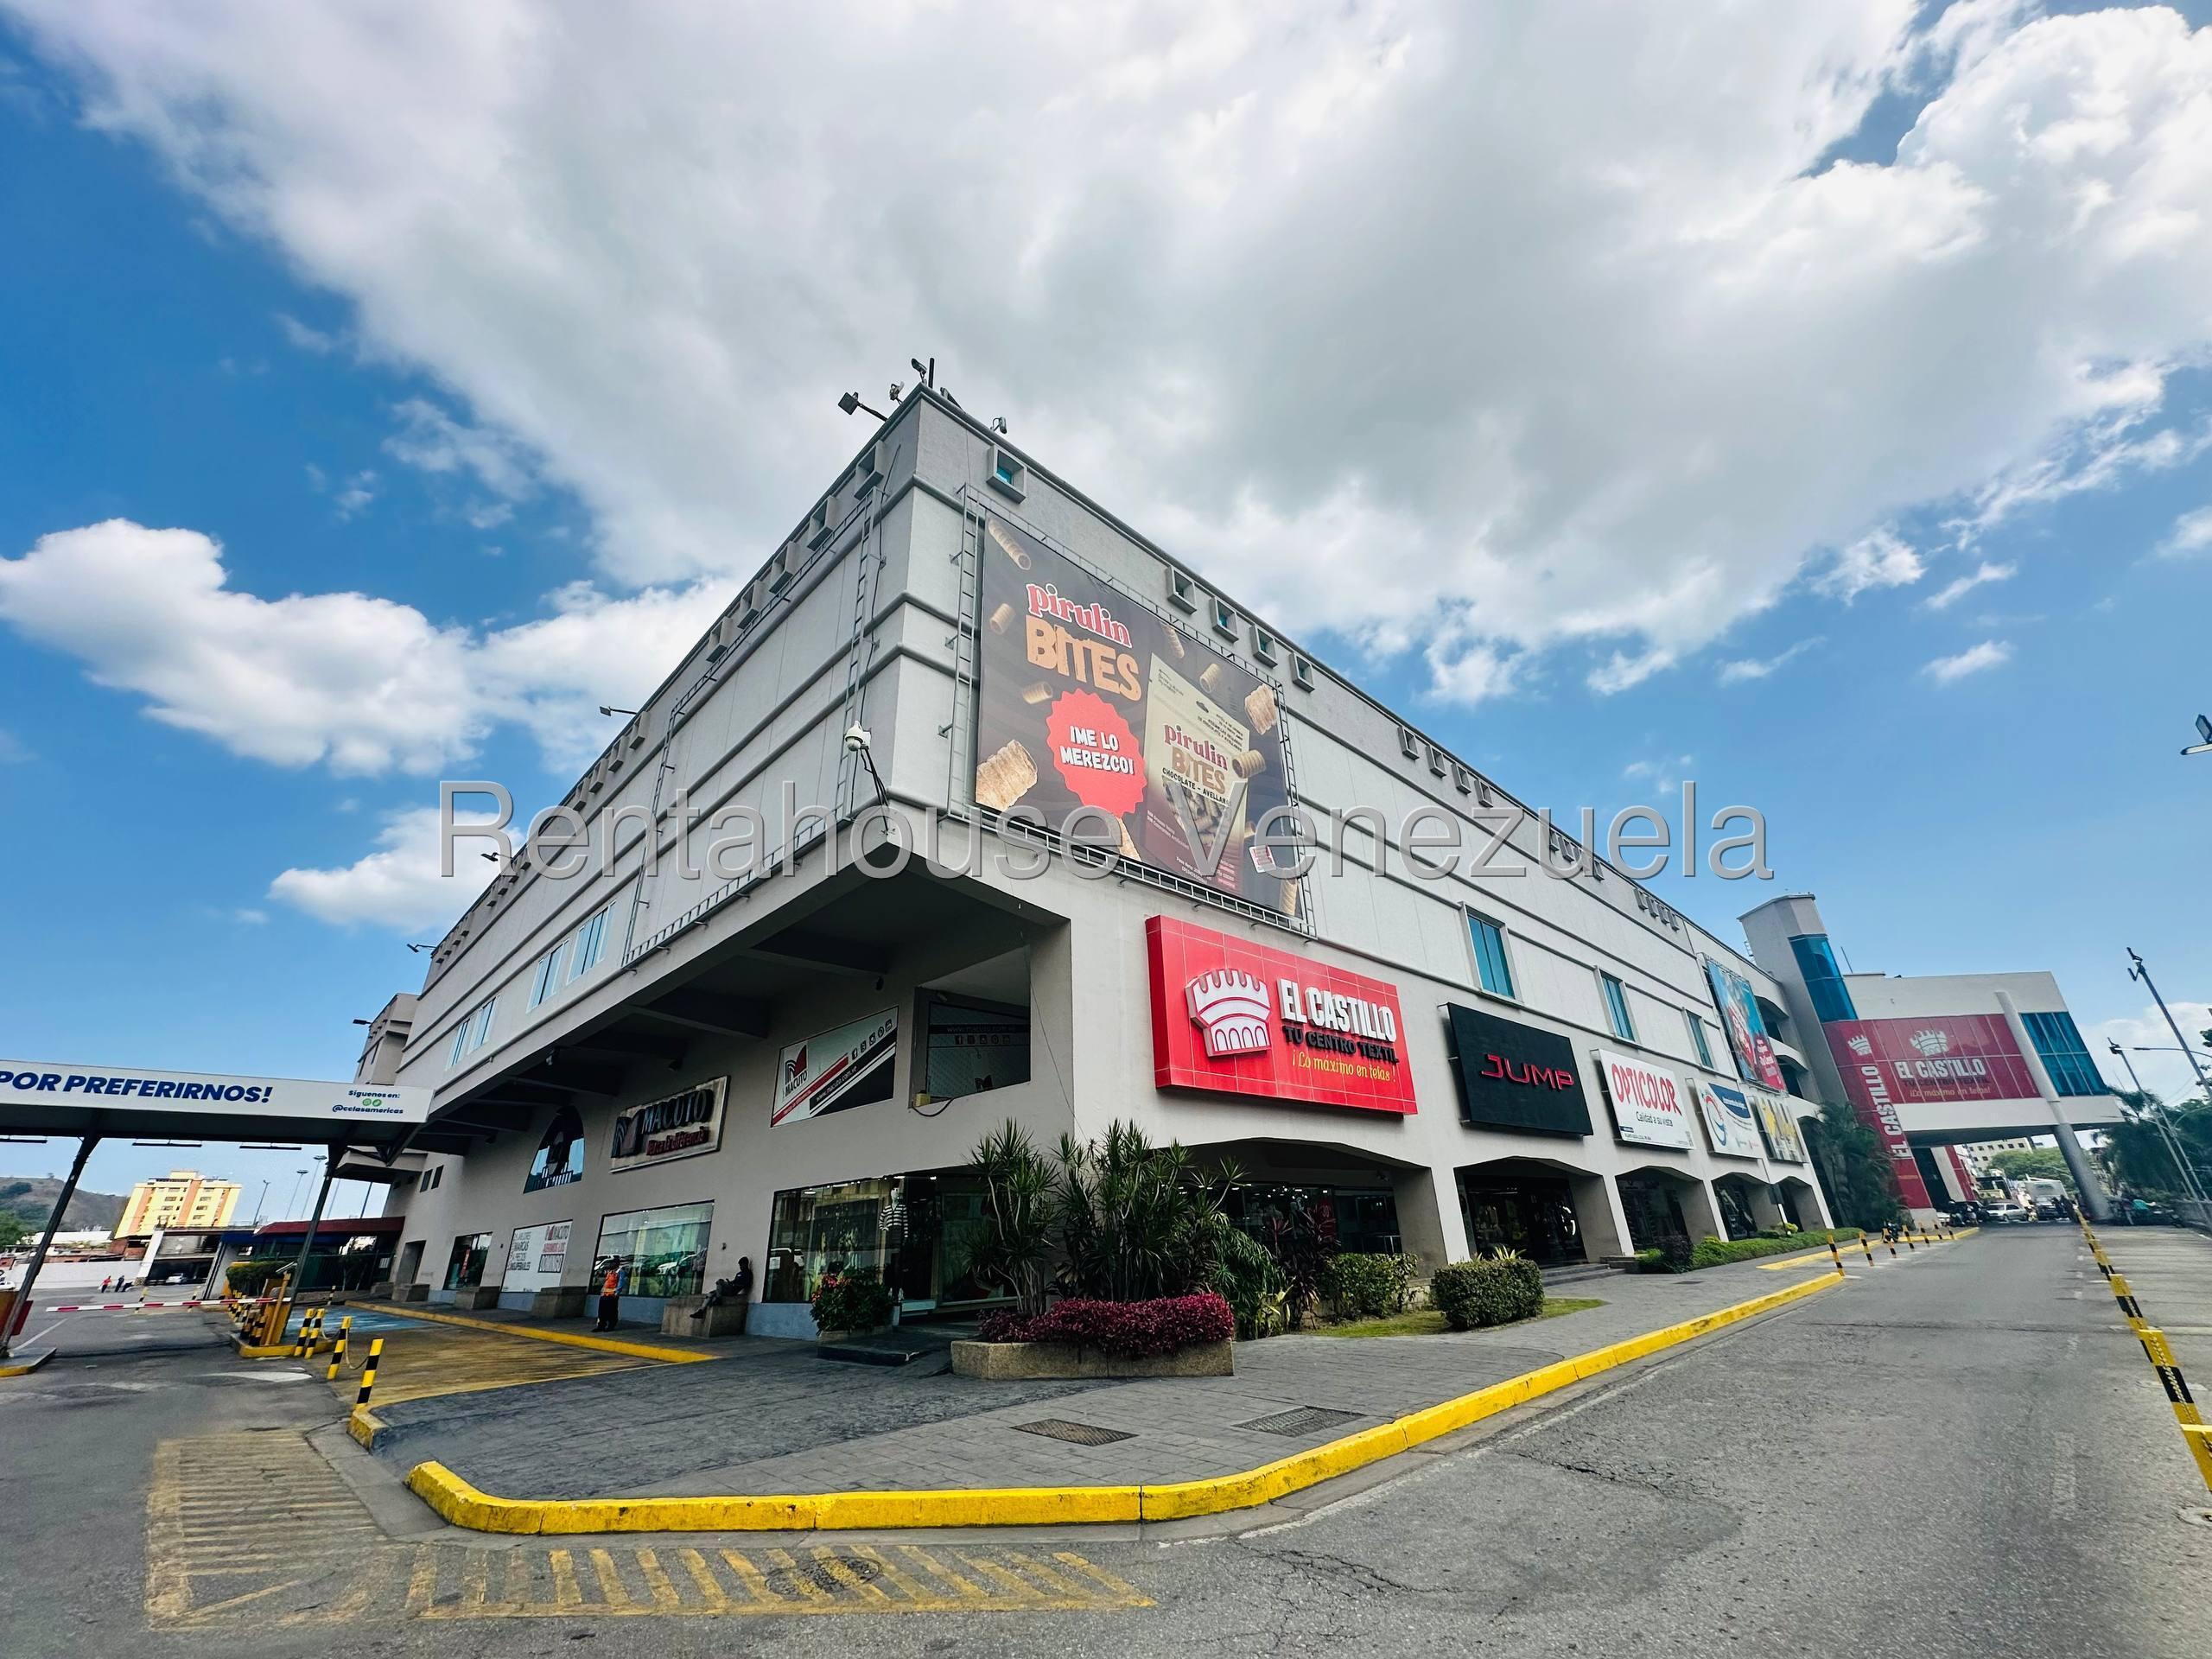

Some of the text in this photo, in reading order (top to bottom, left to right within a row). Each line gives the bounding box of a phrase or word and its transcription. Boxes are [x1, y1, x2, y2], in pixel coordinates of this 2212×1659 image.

[1026, 583, 1132, 648] pirulin
[1026, 614, 1141, 701] BITES
[1101, 732, 1119, 751] LO
[1163, 724, 1228, 771] pirulin
[1162, 767, 1195, 790] CHOCOLATE
[1172, 747, 1225, 794] BITES
[1277, 978, 1396, 1043] EL CASTILLO
[1282, 1026, 1399, 1064] TU CENTRO TEXTIL
[785, 1071, 808, 1097] MACUTO
[1313, 1055, 1353, 1075] máximo
[1356, 1065, 1367, 1077] en
[1480, 1053, 1574, 1090] JUMP
[1894, 1058, 1986, 1078] EL CASTILLO
[63, 1075, 273, 1103] PREFERIRNOS!
[1611, 1064, 1682, 1116] OPTICOLOR
[1861, 1065, 1902, 1136] CASTILLO
[332, 1104, 404, 1114] @cclasamericas
[641, 1089, 712, 1135] MACUTO
[1891, 1141, 1911, 1159] EL
